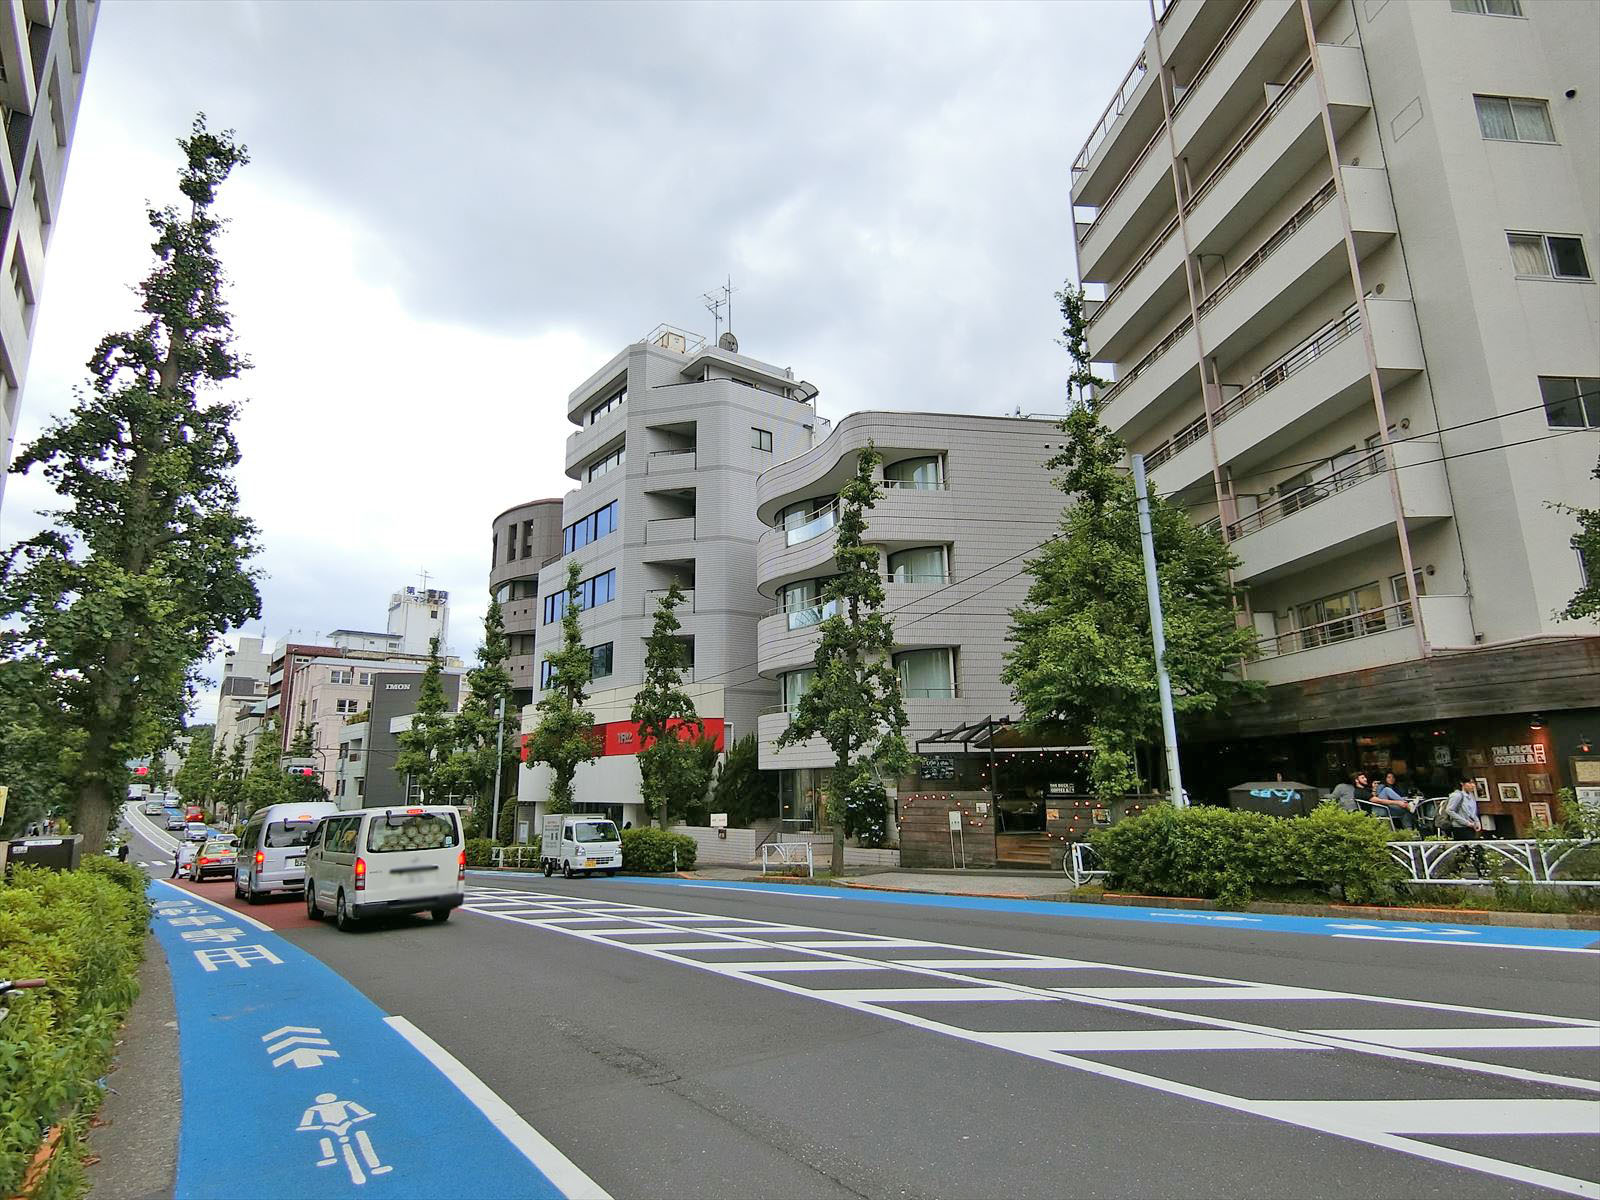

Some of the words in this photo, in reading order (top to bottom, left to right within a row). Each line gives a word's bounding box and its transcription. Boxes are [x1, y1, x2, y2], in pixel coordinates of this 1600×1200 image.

[1491, 746, 1508, 755] THE
[1508, 744, 1534, 754] DECK
[1534, 744, 1546, 762] PIE
[1495, 754, 1526, 764] COFFEE
